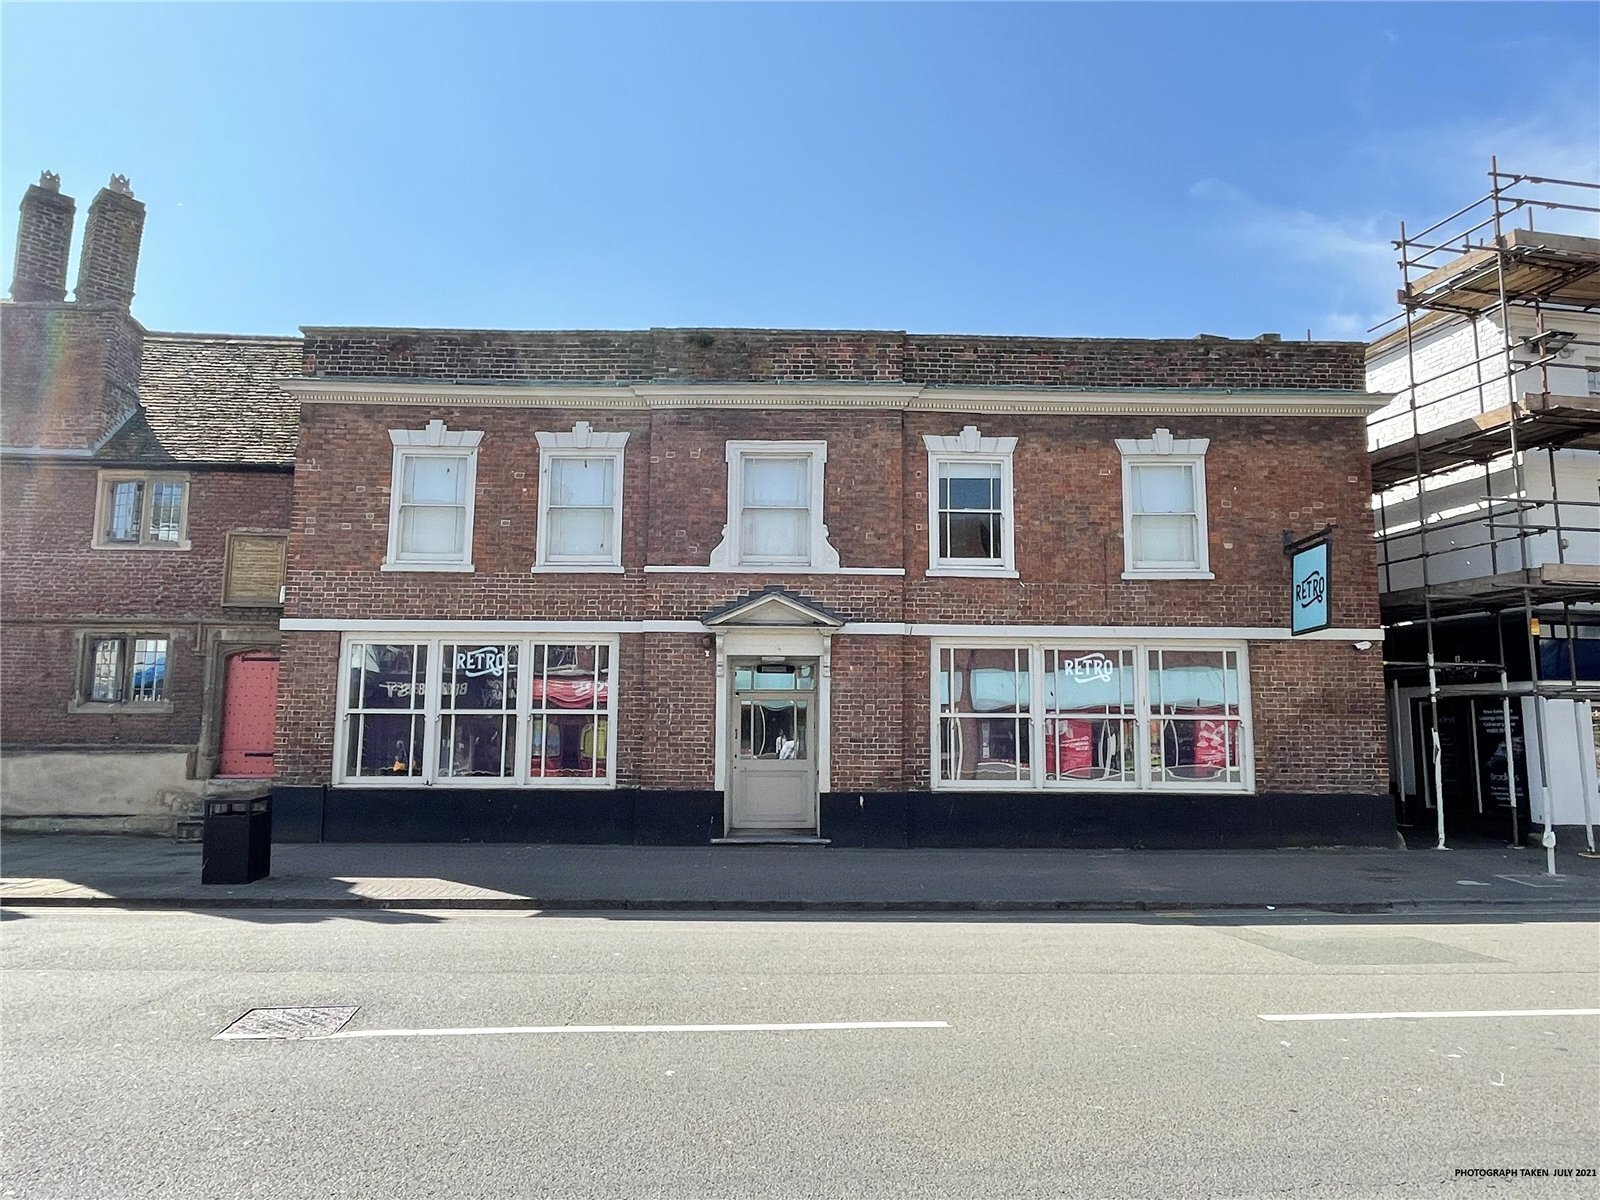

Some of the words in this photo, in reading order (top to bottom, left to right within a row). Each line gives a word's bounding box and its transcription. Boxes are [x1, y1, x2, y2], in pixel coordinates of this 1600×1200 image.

[1296, 571, 1325, 608] RETRO
[456, 646, 505, 677] RETRO
[1064, 652, 1113, 683] RETRO
